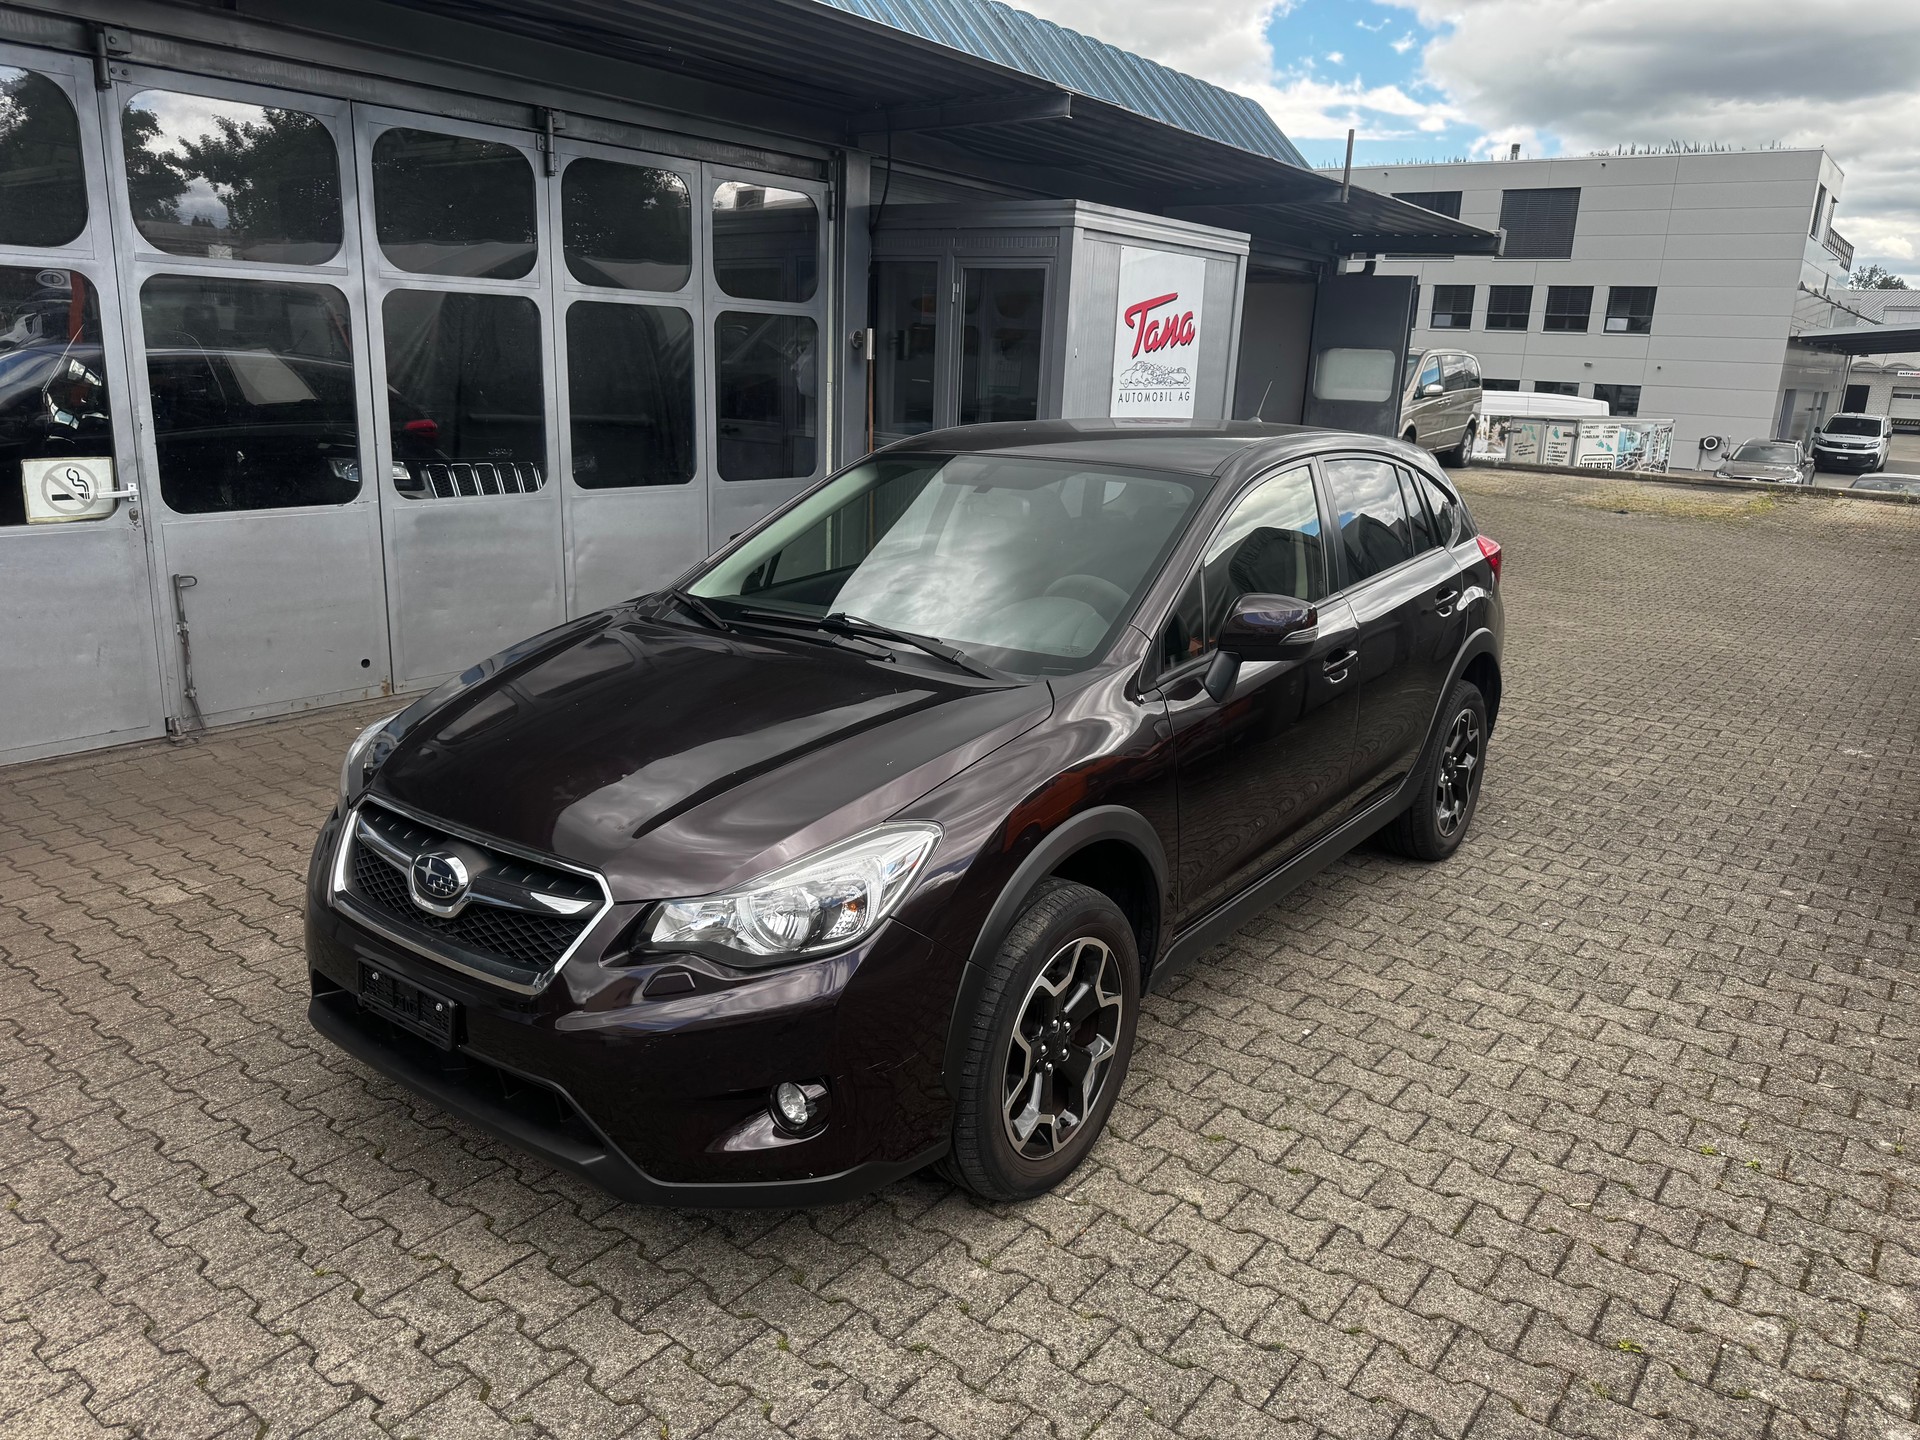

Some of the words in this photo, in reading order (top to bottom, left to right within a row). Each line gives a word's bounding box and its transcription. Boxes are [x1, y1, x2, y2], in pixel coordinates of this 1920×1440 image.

[1124, 292, 1195, 359] Tana
[1118, 391, 1172, 403] AUTOMOBIL
[1178, 391, 1190, 402] AG
